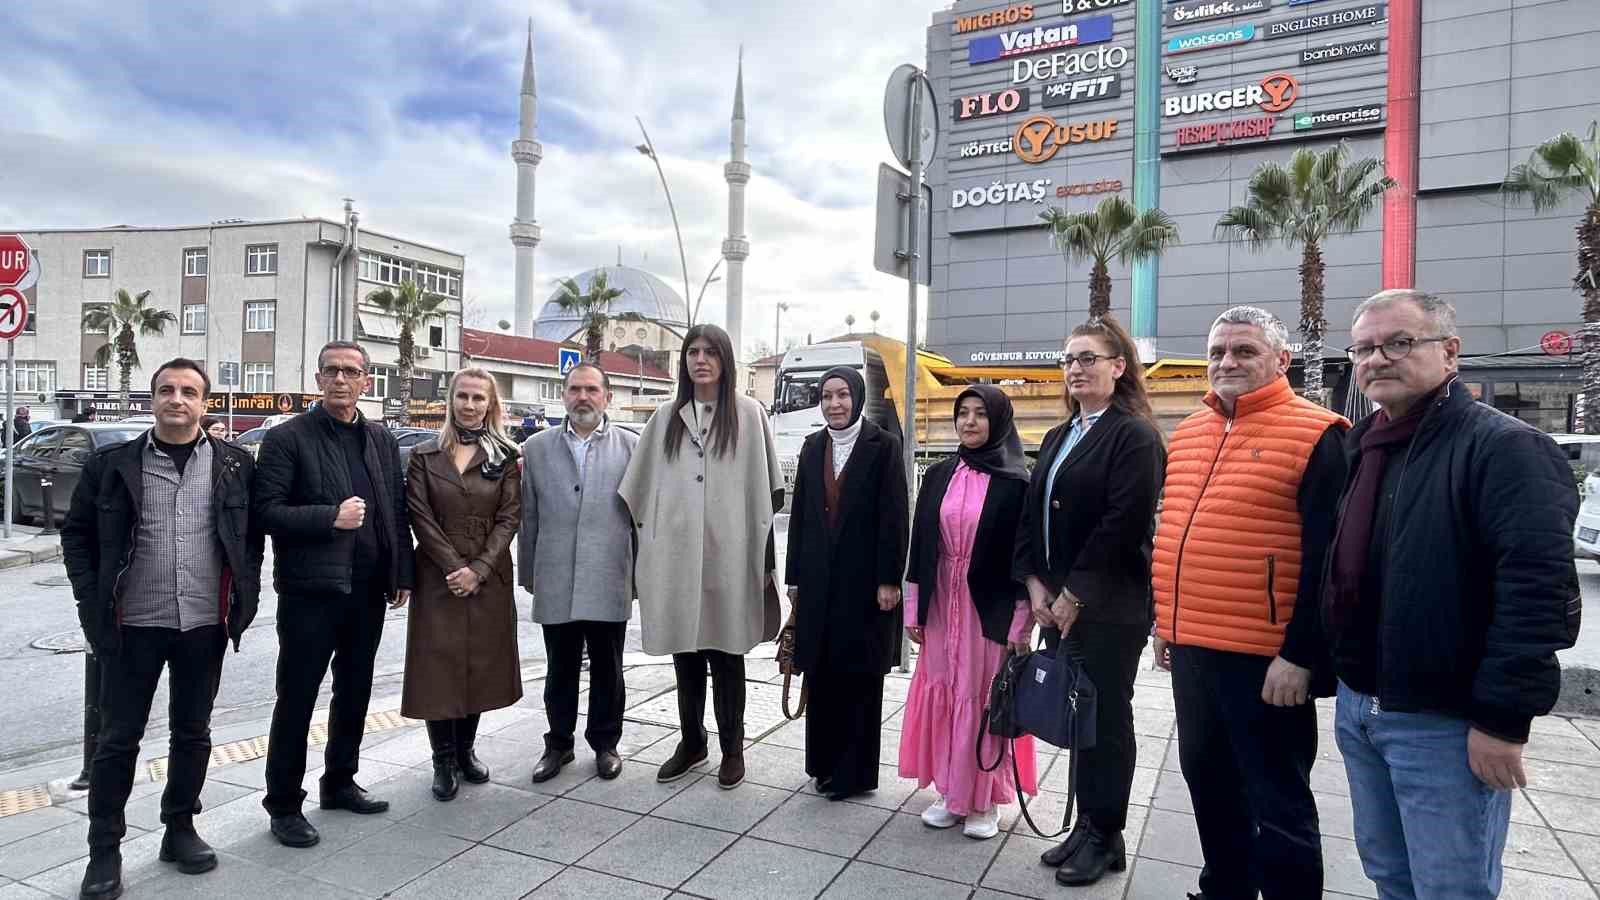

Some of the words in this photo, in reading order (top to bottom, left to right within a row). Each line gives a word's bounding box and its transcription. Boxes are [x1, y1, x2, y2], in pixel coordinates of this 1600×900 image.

[1271, 14, 1329, 34] ENGLISH
[1332, 7, 1377, 24] HOME
[1000, 24, 1078, 50] Vatan
[1179, 30, 1243, 48] watsons
[1013, 45, 1128, 83] DeFacto
[1303, 47, 1343, 60] bambi
[1344, 42, 1376, 55] YATAK
[960, 90, 1021, 117] FLO
[1165, 85, 1264, 116] BURGER
[1300, 107, 1380, 124] enterprise
[1023, 119, 1118, 156] YUSUF
[952, 179, 1047, 208] DOĞTAŞ
[2, 250, 25, 269] UR
